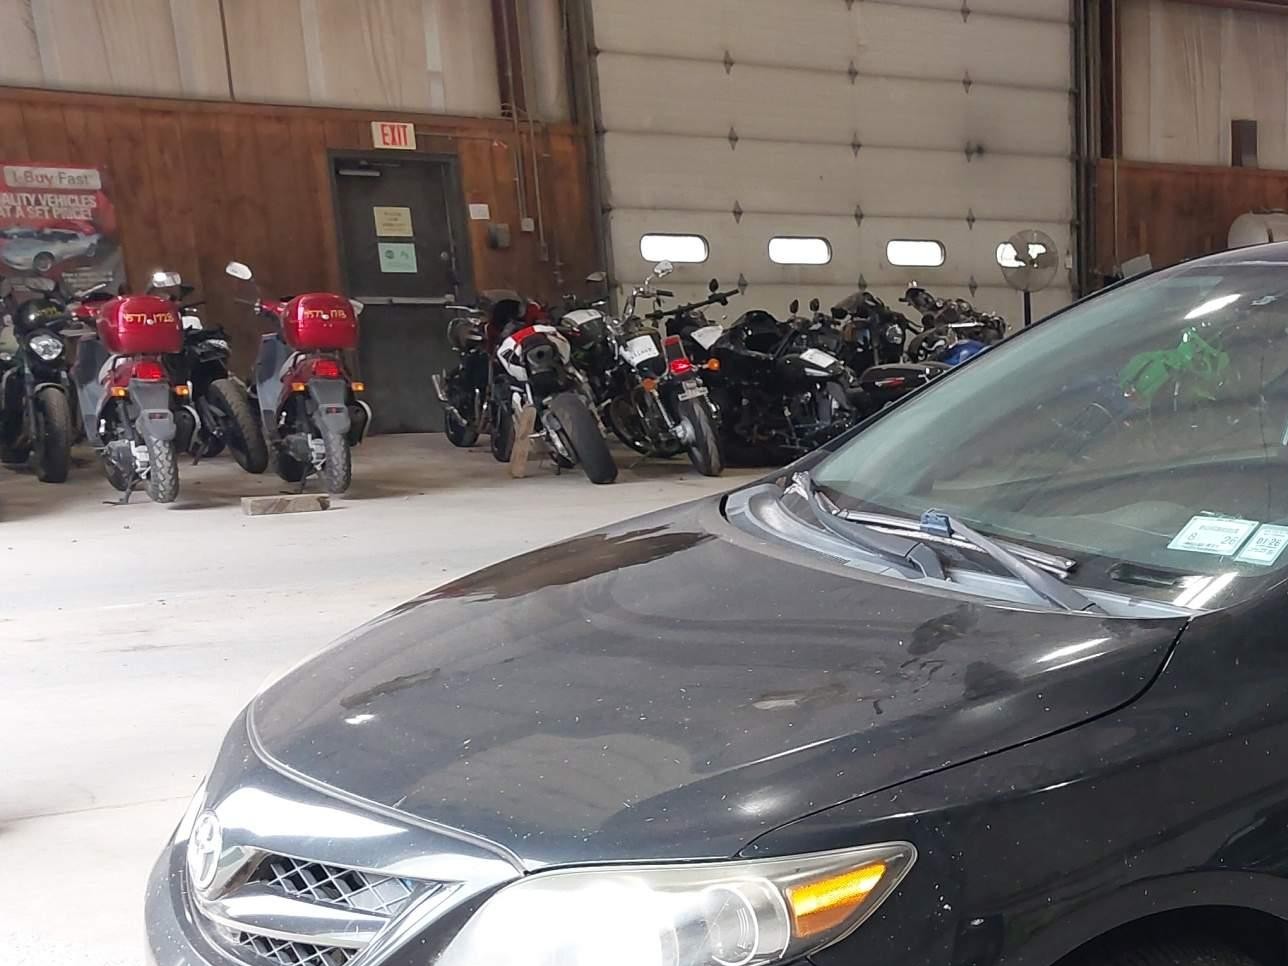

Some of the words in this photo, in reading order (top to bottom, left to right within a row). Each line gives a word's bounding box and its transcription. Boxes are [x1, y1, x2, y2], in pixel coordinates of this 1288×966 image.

[380, 124, 408, 146] EXIT
[0, 191, 36, 206] ALITY
[38, 192, 97, 208] VEHICLES
